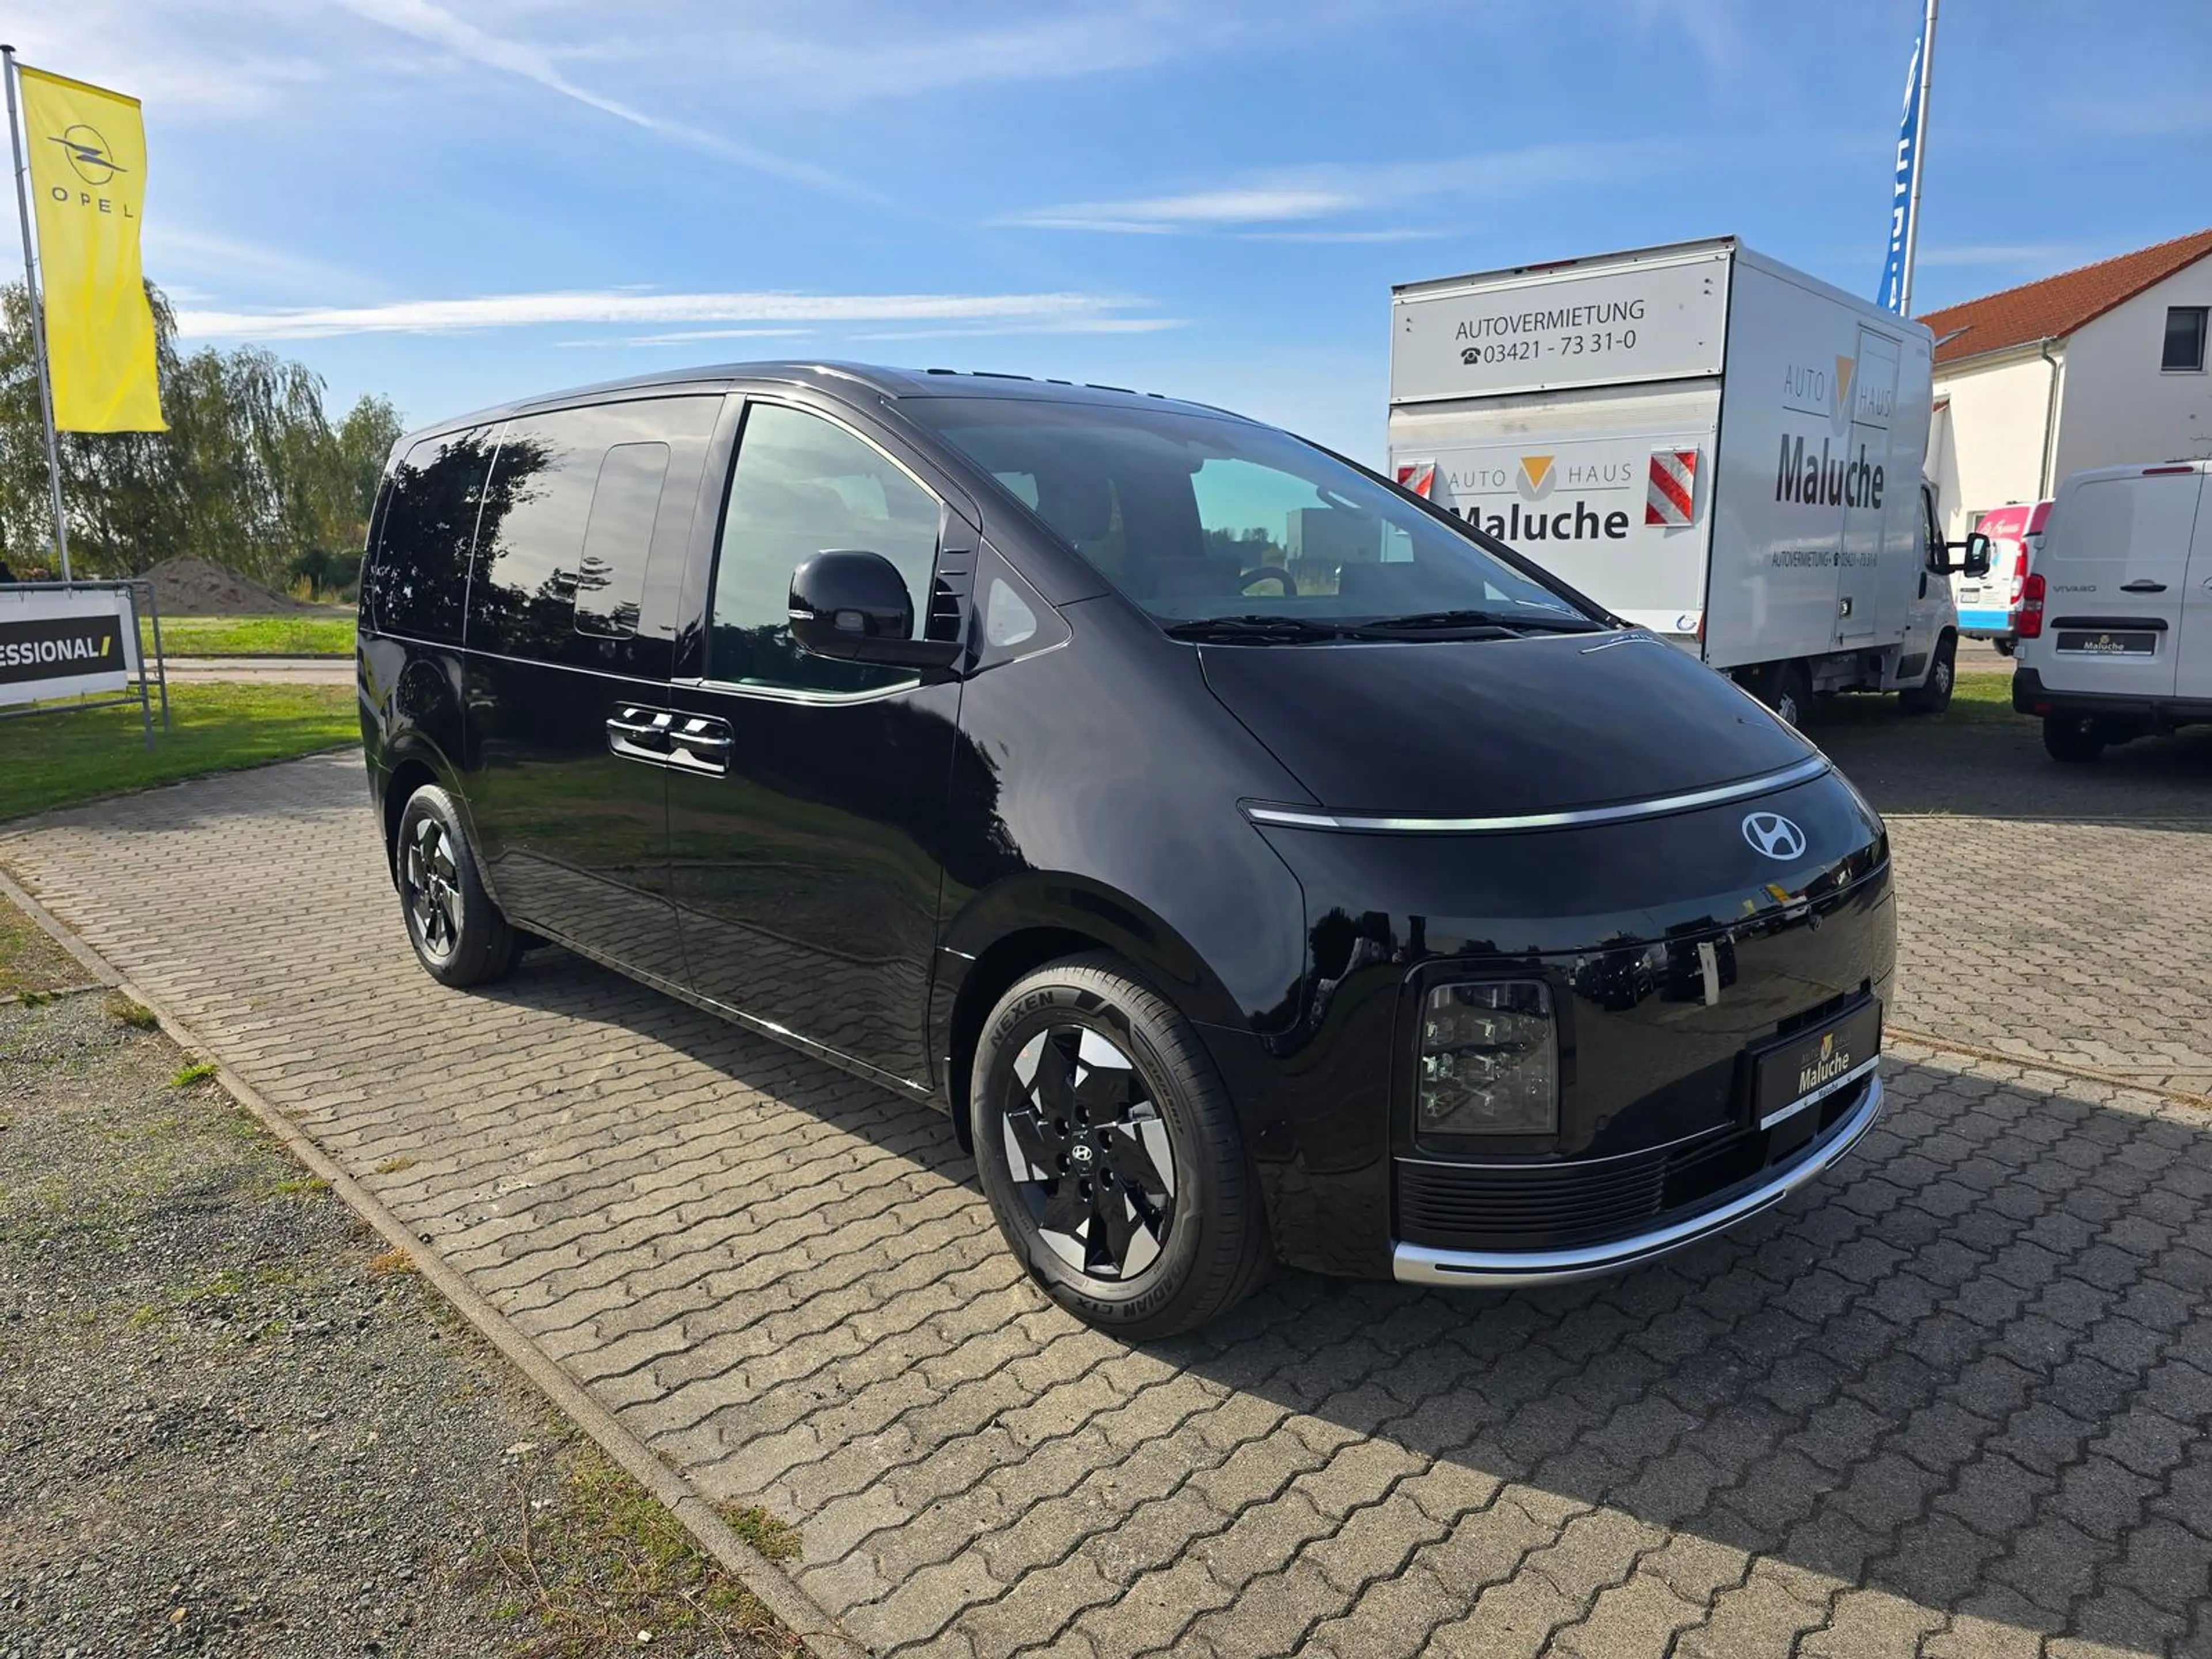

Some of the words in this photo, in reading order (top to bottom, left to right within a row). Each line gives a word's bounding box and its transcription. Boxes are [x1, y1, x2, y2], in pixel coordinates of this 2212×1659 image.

[52, 187, 134, 218] OPEL
[1455, 300, 1645, 340] AUTOVERMIETUNG
[1483, 340, 1539, 363] 03421
[1561, 335, 1584, 356] 73
[1590, 330, 1637, 353] 31-0
[1783, 364, 1824, 402] AUTO
[1859, 385, 1891, 418] HAUS
[1448, 469, 1506, 488] AUTO
[1569, 463, 1632, 483] HAUS
[1775, 433, 1884, 510] Maluche
[2083, 641, 2124, 651] Maluche
[990, 991, 1054, 1049] NEXEN
[1798, 1051, 1850, 1094] Maluche
